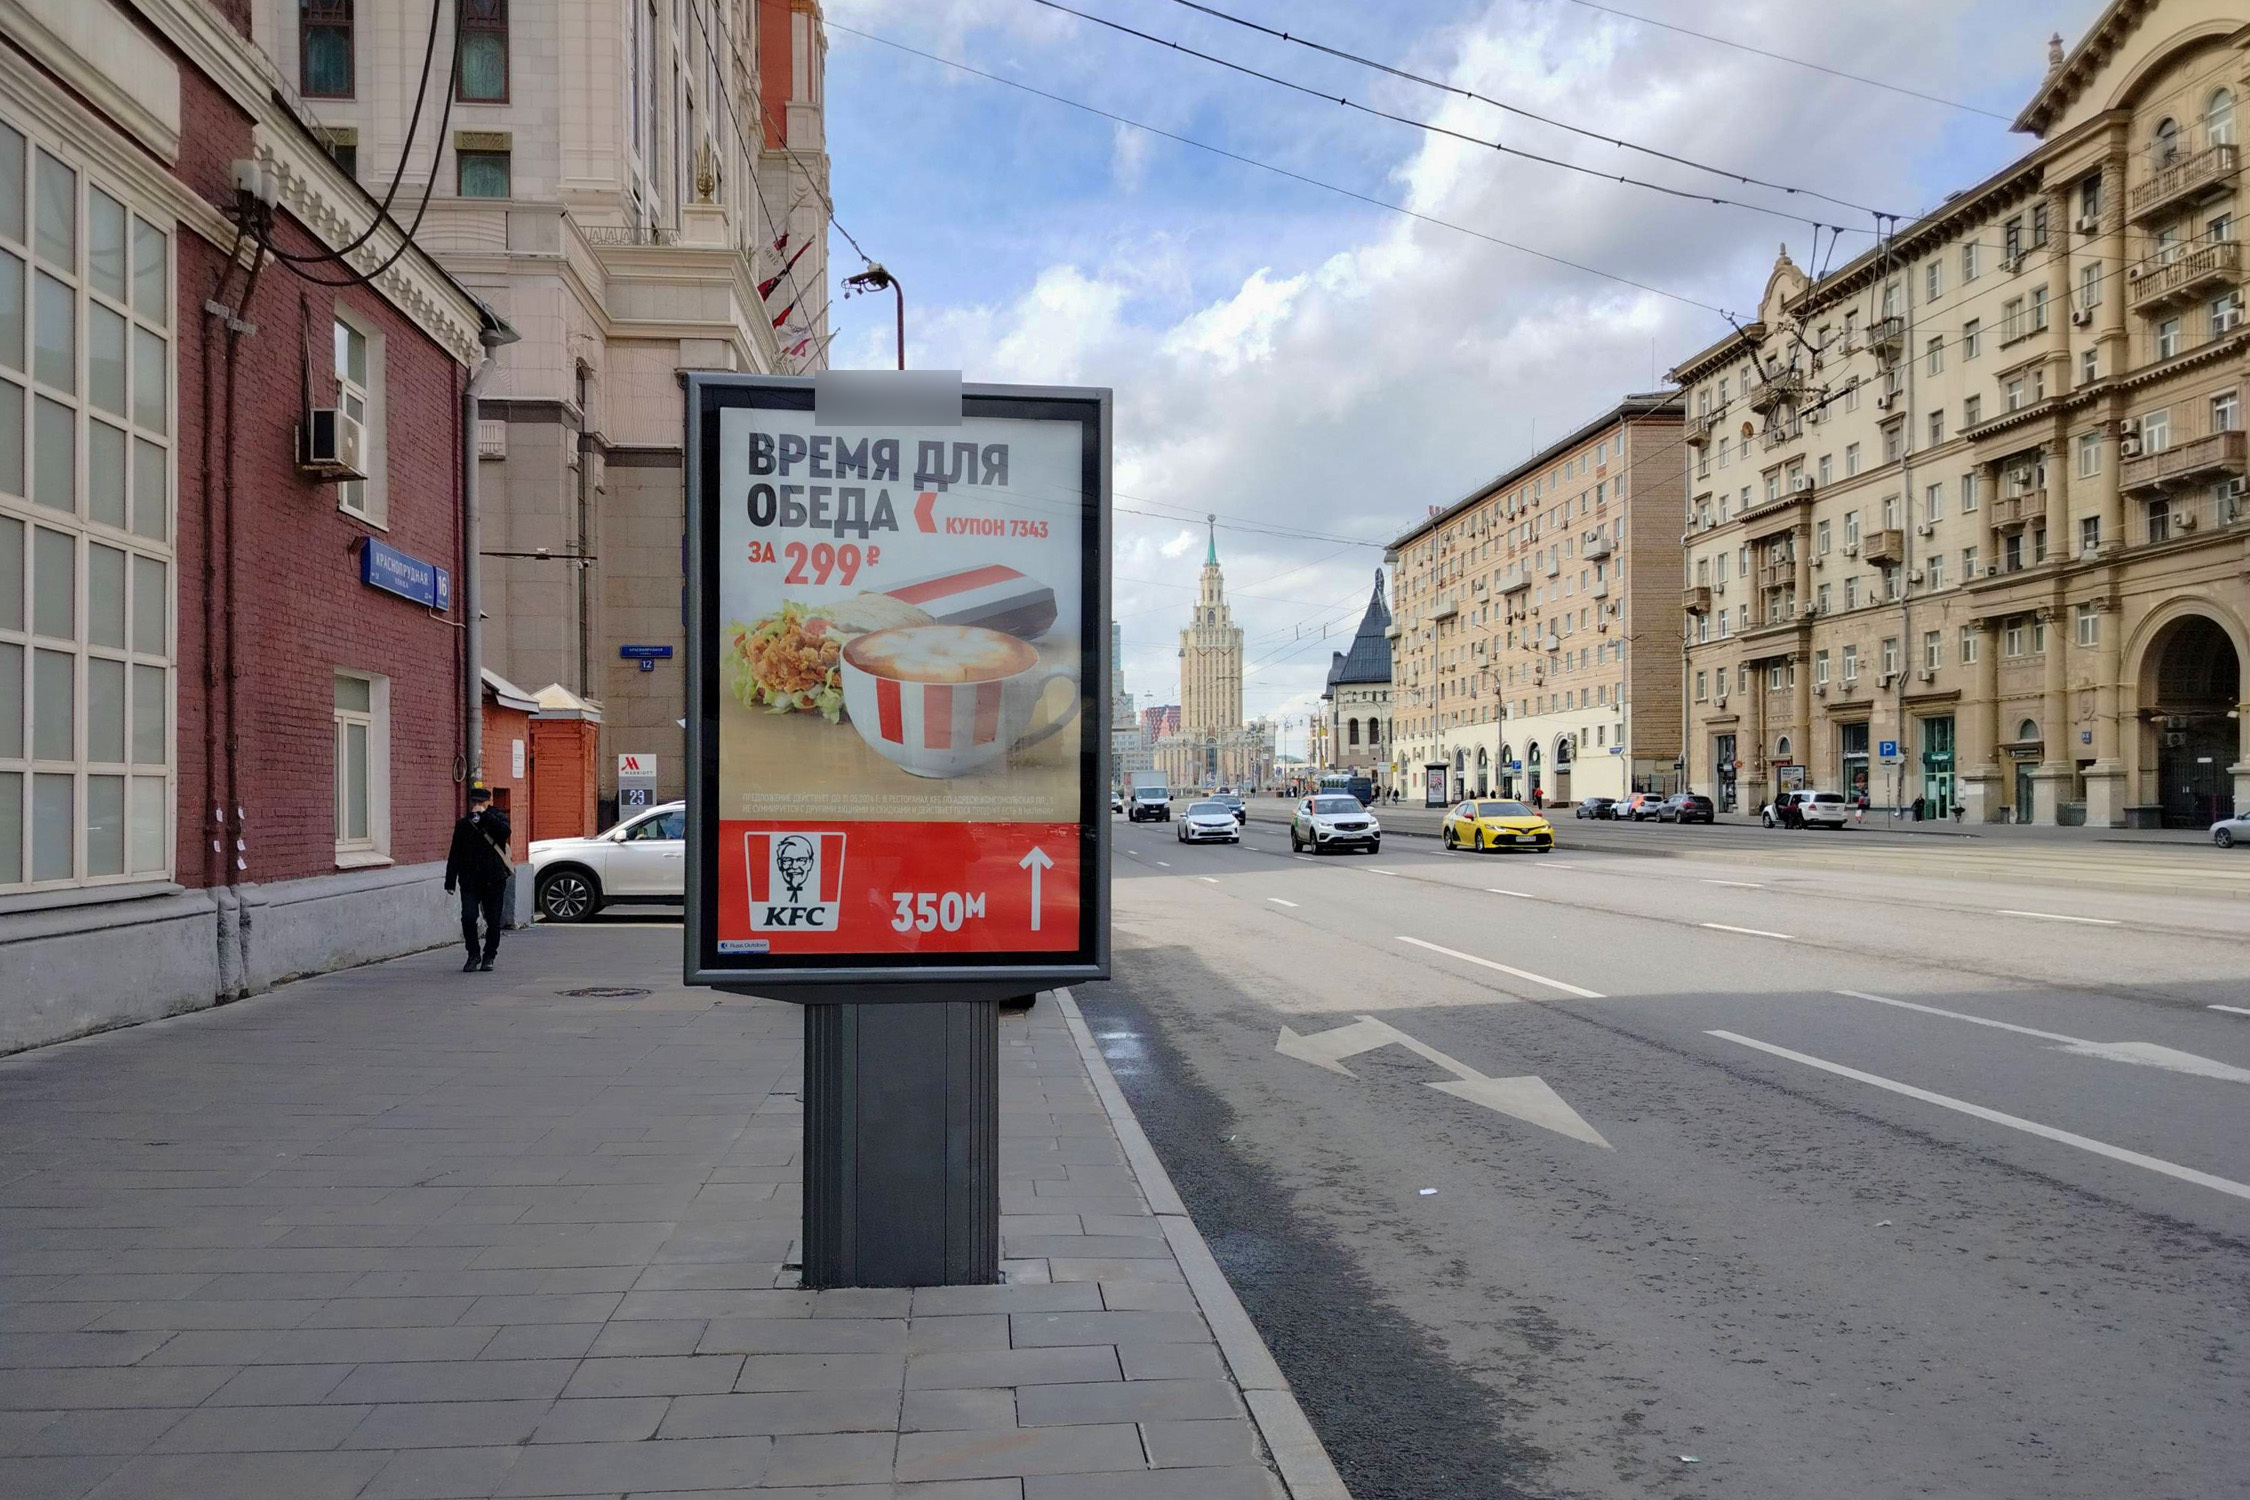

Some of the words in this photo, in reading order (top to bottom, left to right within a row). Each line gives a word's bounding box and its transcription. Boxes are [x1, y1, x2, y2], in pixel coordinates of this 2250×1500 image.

[748, 433, 900, 481] ВРЕМЯ
[914, 441, 1009, 492] ДЛЯ
[747, 484, 899, 539] ОБЕДА
[945, 517, 1005, 537] КУПОН
[1009, 520, 1049, 539] 7343
[747, 541, 776, 563] ЗА
[376, 552, 429, 586] КРАСНОПРУДНАЯ
[438, 576, 447, 597] 16
[642, 660, 652, 668] 12
[1884, 743, 1893, 755] P
[1515, 761, 1520, 769] P
[630, 790, 645, 805] 23
[763, 906, 825, 926] KFC
